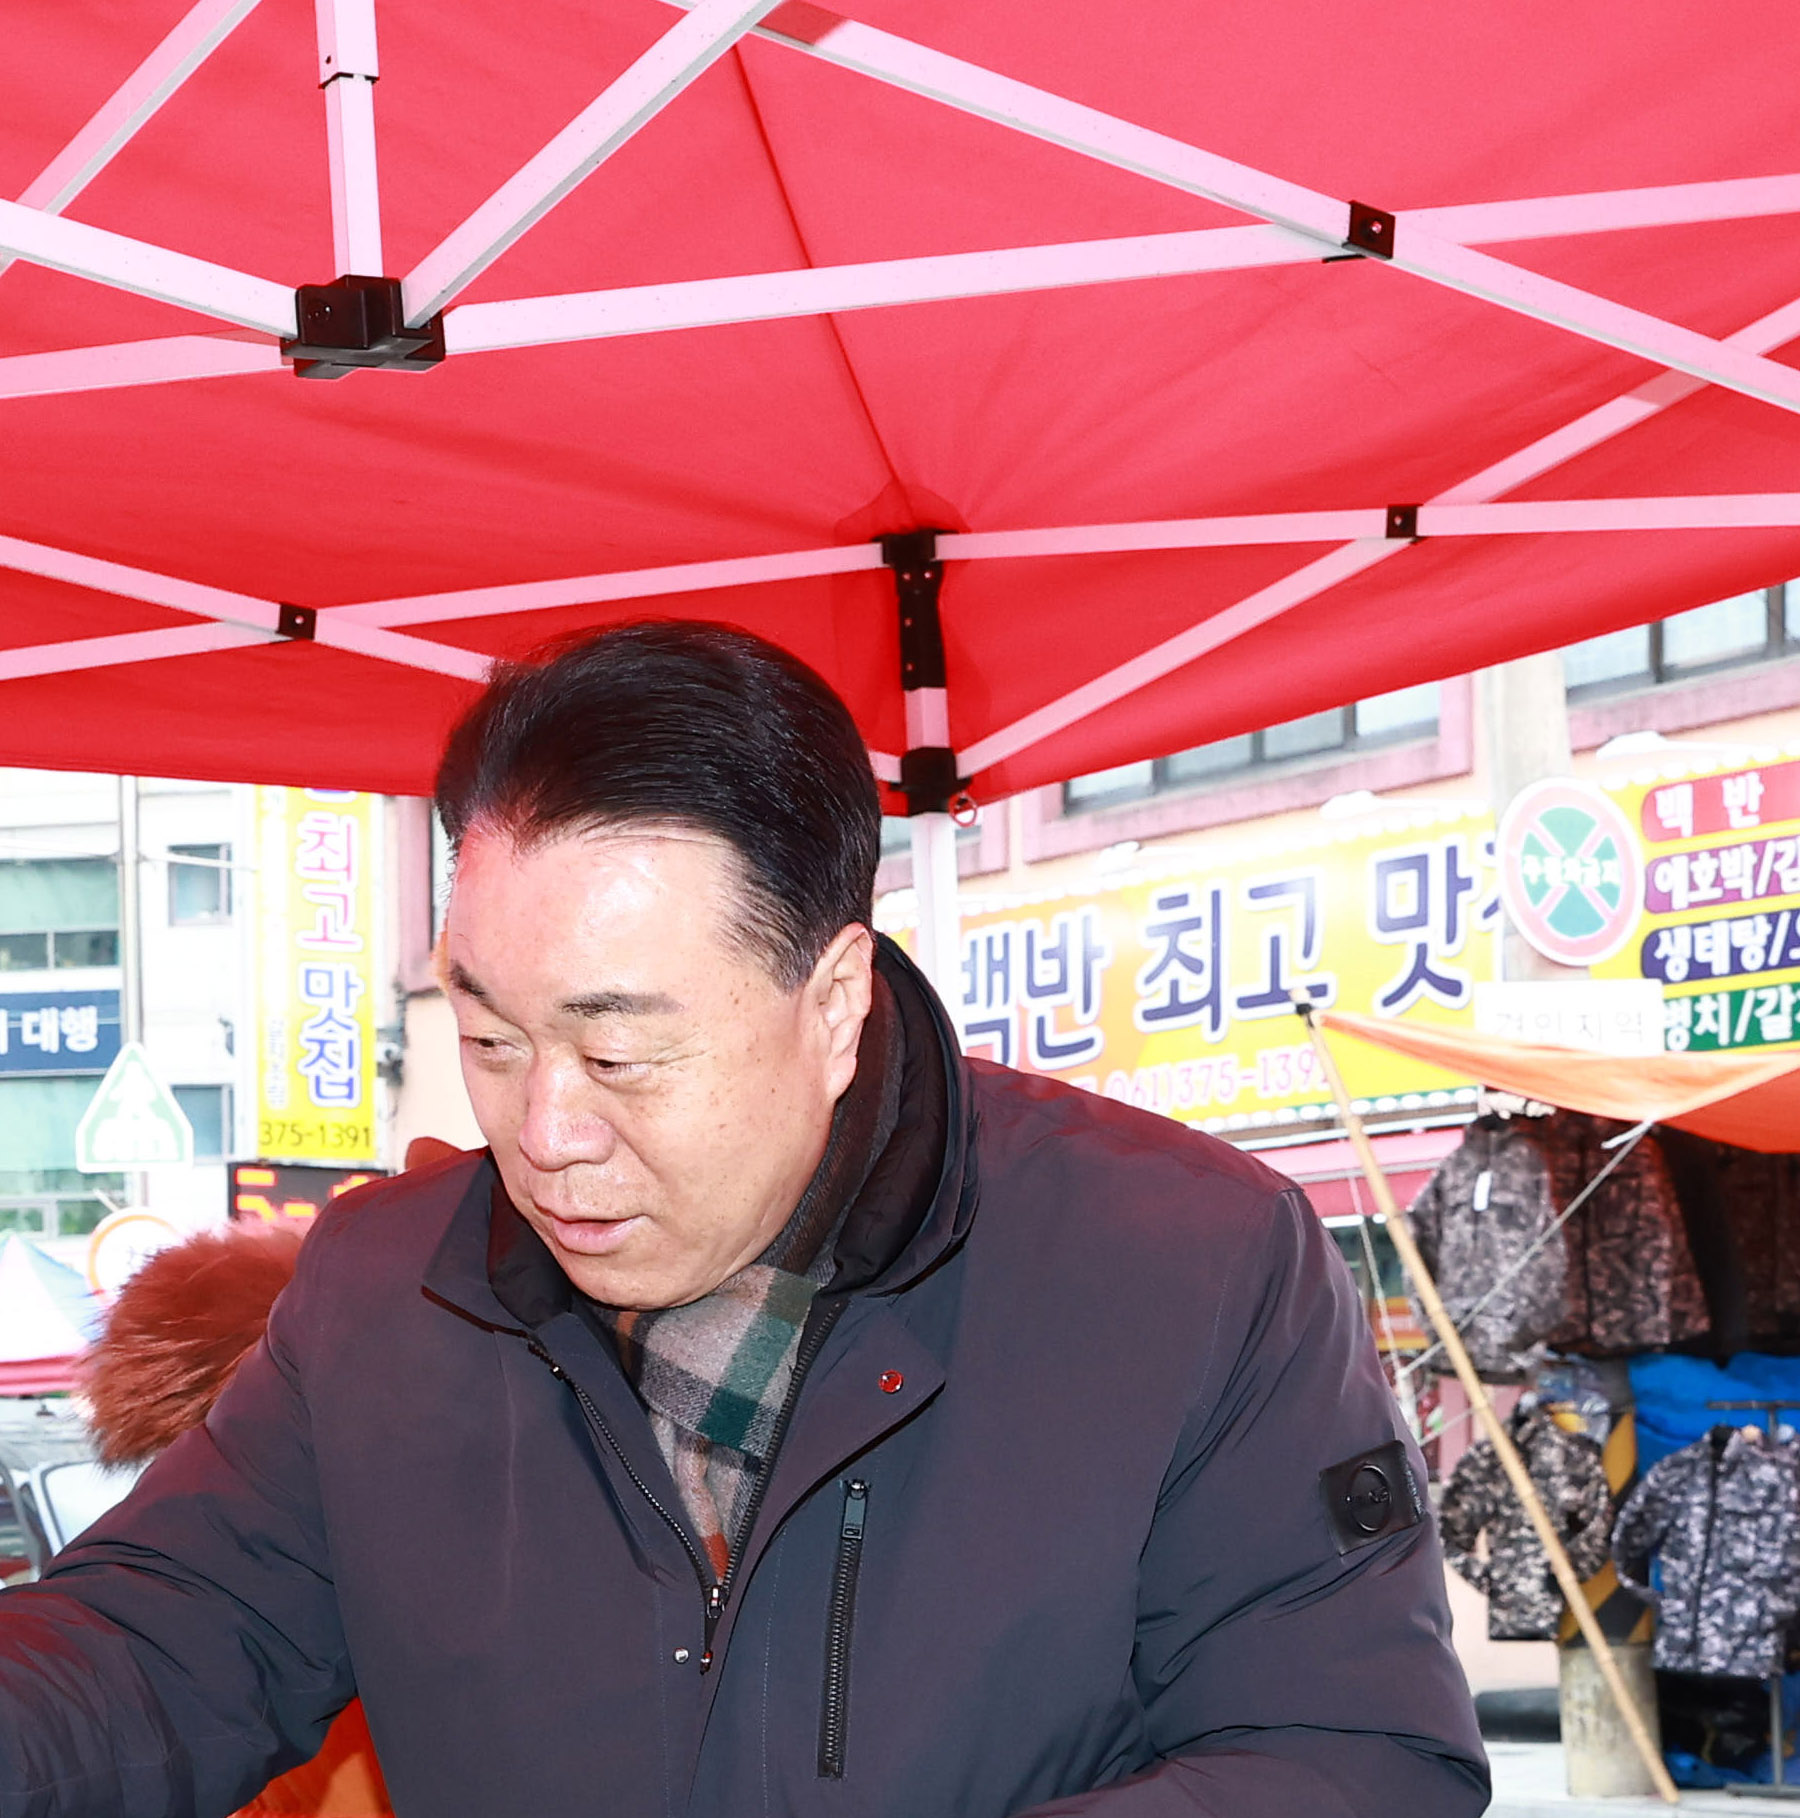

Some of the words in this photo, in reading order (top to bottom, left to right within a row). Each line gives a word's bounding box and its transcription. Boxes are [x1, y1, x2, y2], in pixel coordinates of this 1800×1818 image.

[298, 814, 363, 952] 최고
[1141, 876, 1329, 1035] 최고
[1375, 838, 1500, 1009] 맛
[21, 1006, 99, 1054] 대행
[299, 963, 364, 1106] 맛집
[259, 1120, 372, 1147] 375-1391
